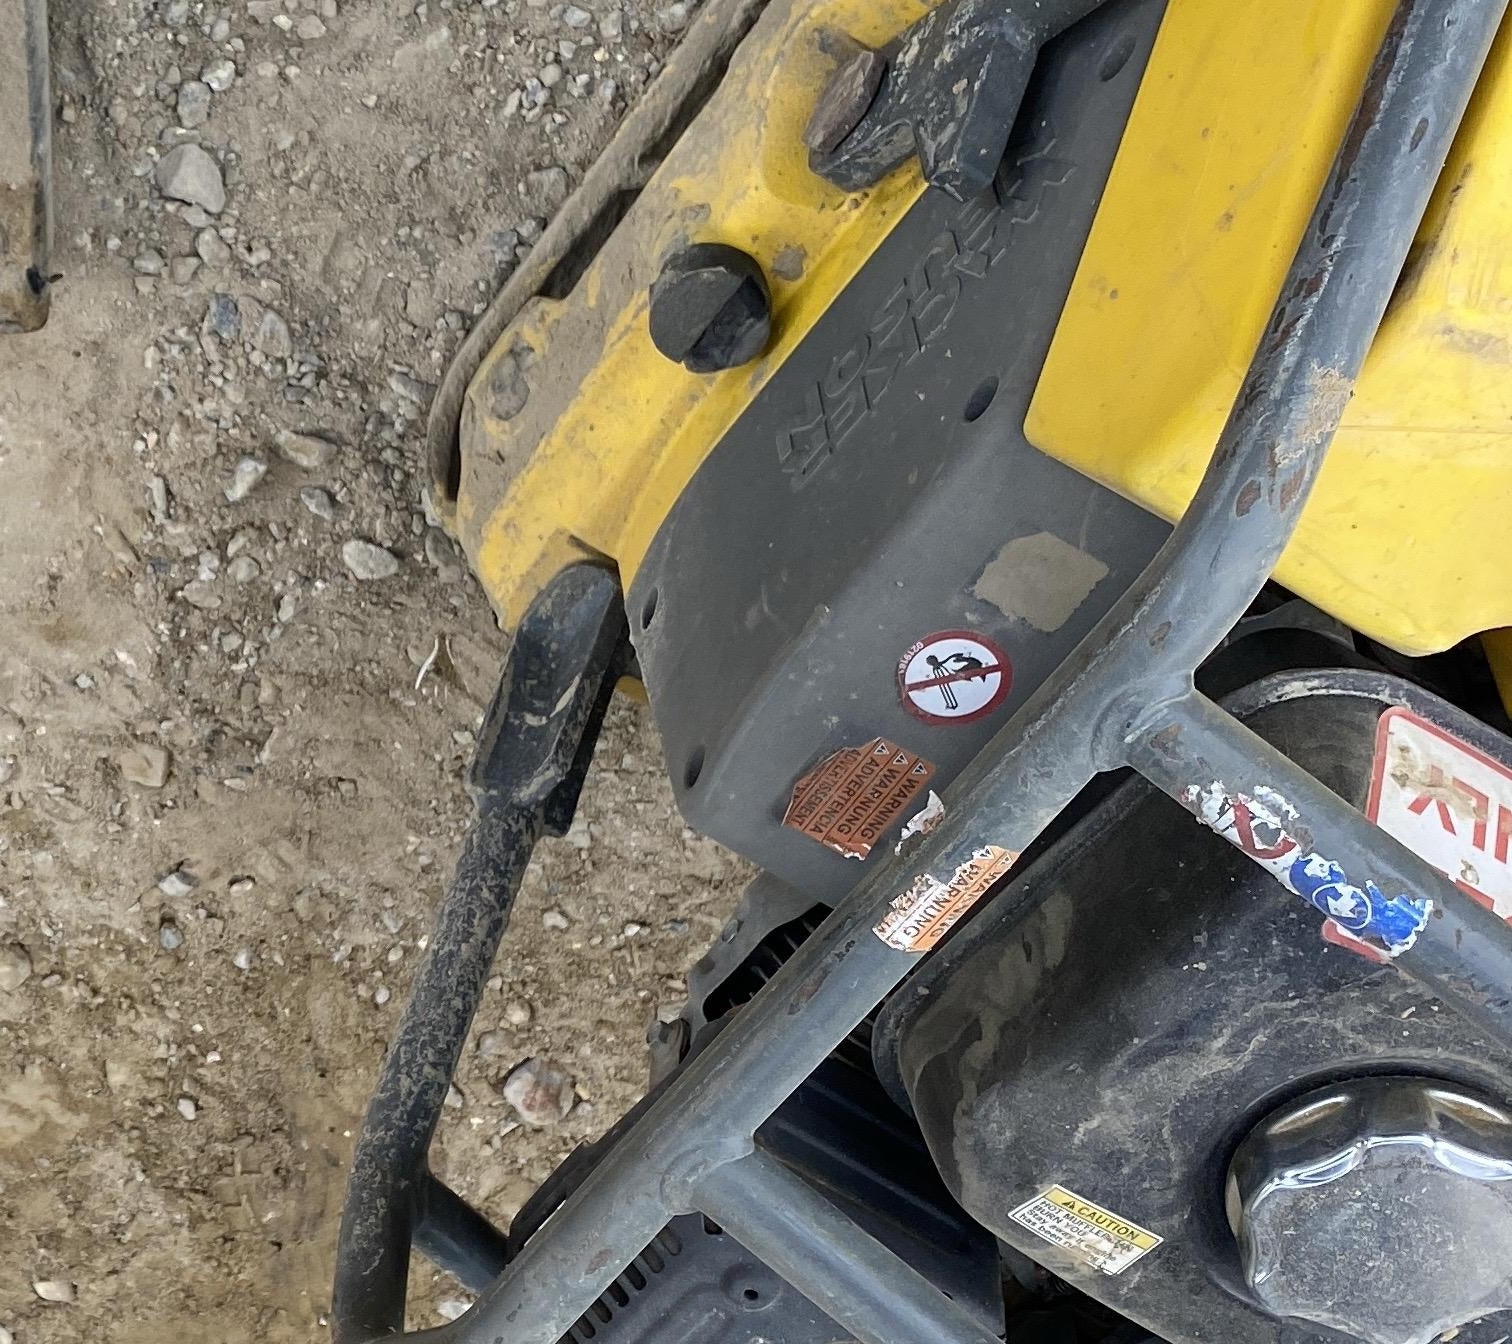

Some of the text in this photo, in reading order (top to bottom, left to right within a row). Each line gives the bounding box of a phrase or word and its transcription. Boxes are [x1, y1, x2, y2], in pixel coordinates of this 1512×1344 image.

[809, 757, 880, 834] ADVERTENCIA
[837, 768, 901, 835] WARNUNG
[861, 778, 919, 839] WARNING
[1028, 1209, 1048, 1225] Stay
[1033, 1205, 1087, 1237] BURN YOU
[1039, 1200, 1062, 1216] HOT
[1077, 1206, 1140, 1241] CAUTION
[1019, 1213, 1037, 1227] has
[1037, 1224, 1063, 1243] been
